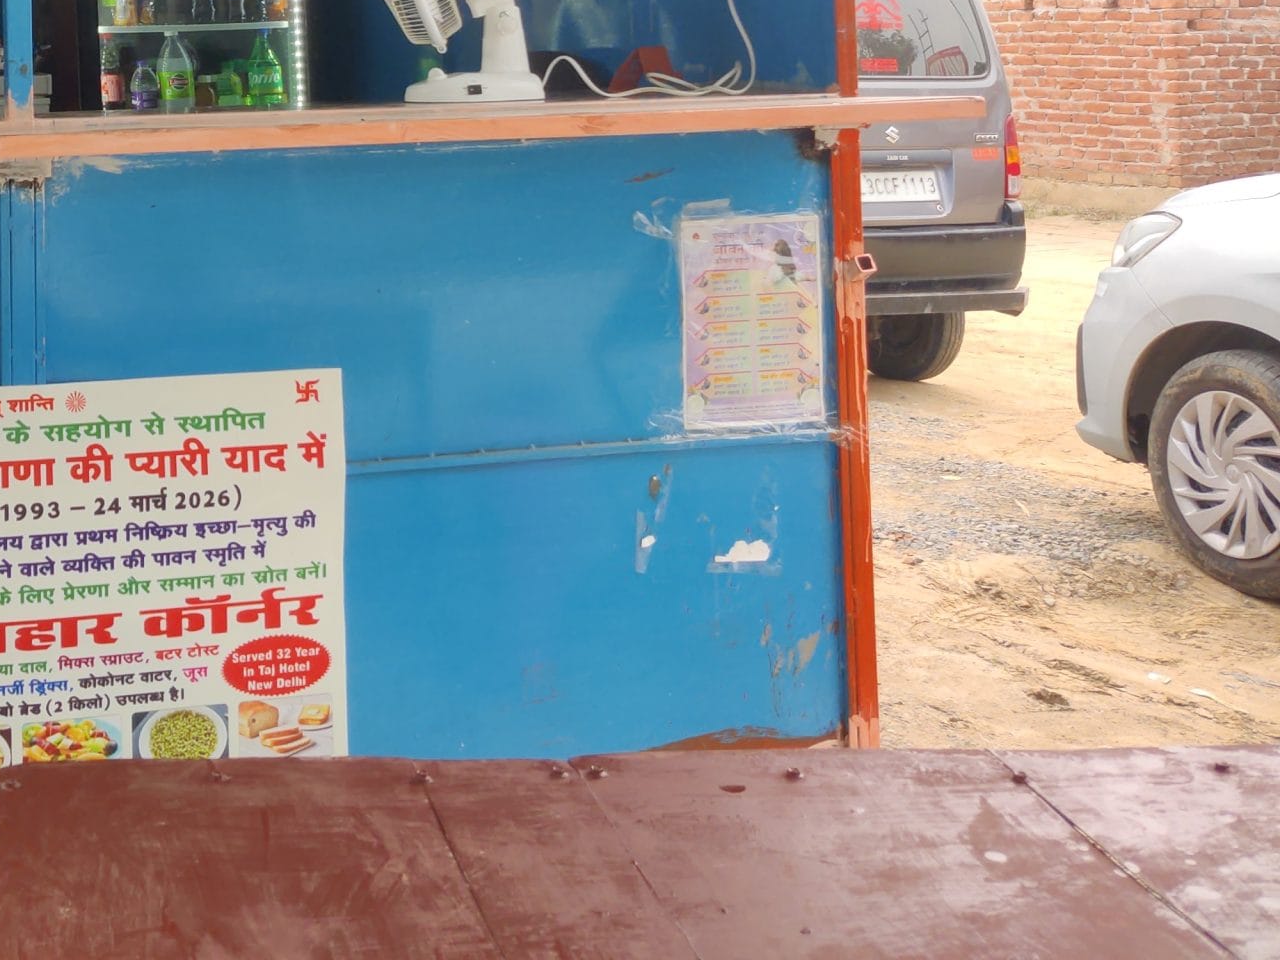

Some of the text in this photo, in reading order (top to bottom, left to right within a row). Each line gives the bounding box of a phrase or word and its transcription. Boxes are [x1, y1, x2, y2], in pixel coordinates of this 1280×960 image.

[862, 177, 936, 195] 3CCF1113
[7, 394, 54, 412] शान्ति
[3, 420, 30, 444] के
[40, 414, 132, 443] सहयोग
[140, 411, 165, 435] से
[174, 407, 266, 433] स्थापित
[66, 443, 113, 483] की
[124, 437, 209, 478] प्यारी
[221, 444, 288, 473] याद
[298, 431, 327, 469] में
[0, 501, 60, 522] 1993
[94, 497, 122, 516] 24
[129, 487, 167, 512] मार्च
[175, 484, 242, 511] 2026)
[29, 532, 68, 550] द्वारा
[74, 528, 118, 546] प्रथम
[293, 509, 316, 528] की
[19, 556, 56, 577] वाले
[61, 552, 115, 573] व्यक्ति
[121, 549, 145, 569] की
[151, 550, 196, 566] पावन
[202, 542, 246, 566] स्मृति
[251, 540, 266, 558] में
[19, 584, 55, 604] लिए
[61, 581, 110, 601] प्रेरणा
[117, 576, 151, 596] और
[157, 574, 214, 593] सम्मान
[222, 572, 244, 587] का
[251, 565, 288, 584] स्रोत
[138, 587, 324, 638] कॉर्नर
[18, 660, 53, 674] दाल,
[57, 655, 94, 671] मिक्स
[155, 647, 182, 661] बटर
[188, 643, 220, 658] टोस्ट
[232, 646, 320, 664] Served 32 Year
[243, 661, 311, 678] in Taj Hotel
[78, 672, 135, 690] कोकोनट
[140, 669, 178, 683] वाटर,
[182, 666, 208, 683] जूस
[247, 675, 306, 691] New Delhi
[18, 701, 42, 716] ब्रेड
[46, 698, 62, 716] (2
[68, 694, 110, 711] किलो)
[116, 692, 164, 706] उपलब्ध
